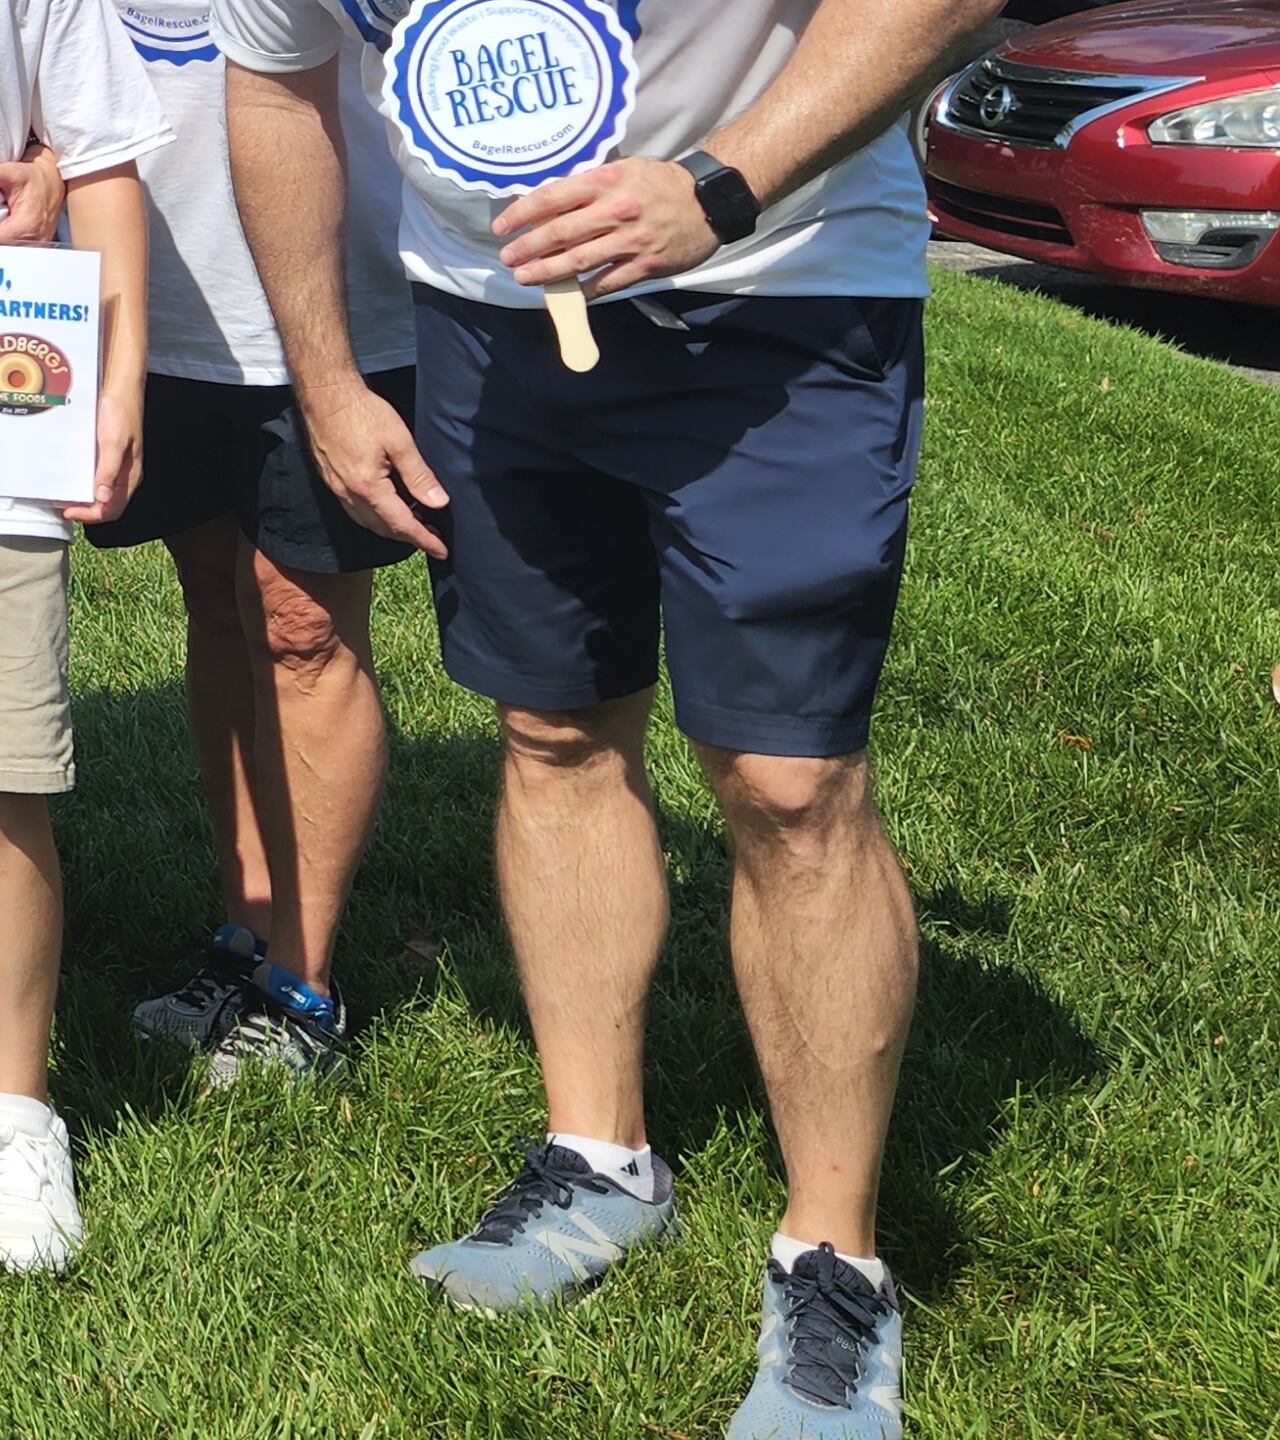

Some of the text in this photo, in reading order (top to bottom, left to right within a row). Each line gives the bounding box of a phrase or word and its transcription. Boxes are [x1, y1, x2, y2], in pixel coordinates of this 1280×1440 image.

[127, 7, 210, 29] BagelRescue.c
[447, 13, 478, 37] Waste
[485, 6, 550, 25] Supporting
[449, 32, 559, 86] BAGEL
[446, 66, 582, 128] RESCUE
[472, 123, 574, 156] BagelRescue.com
